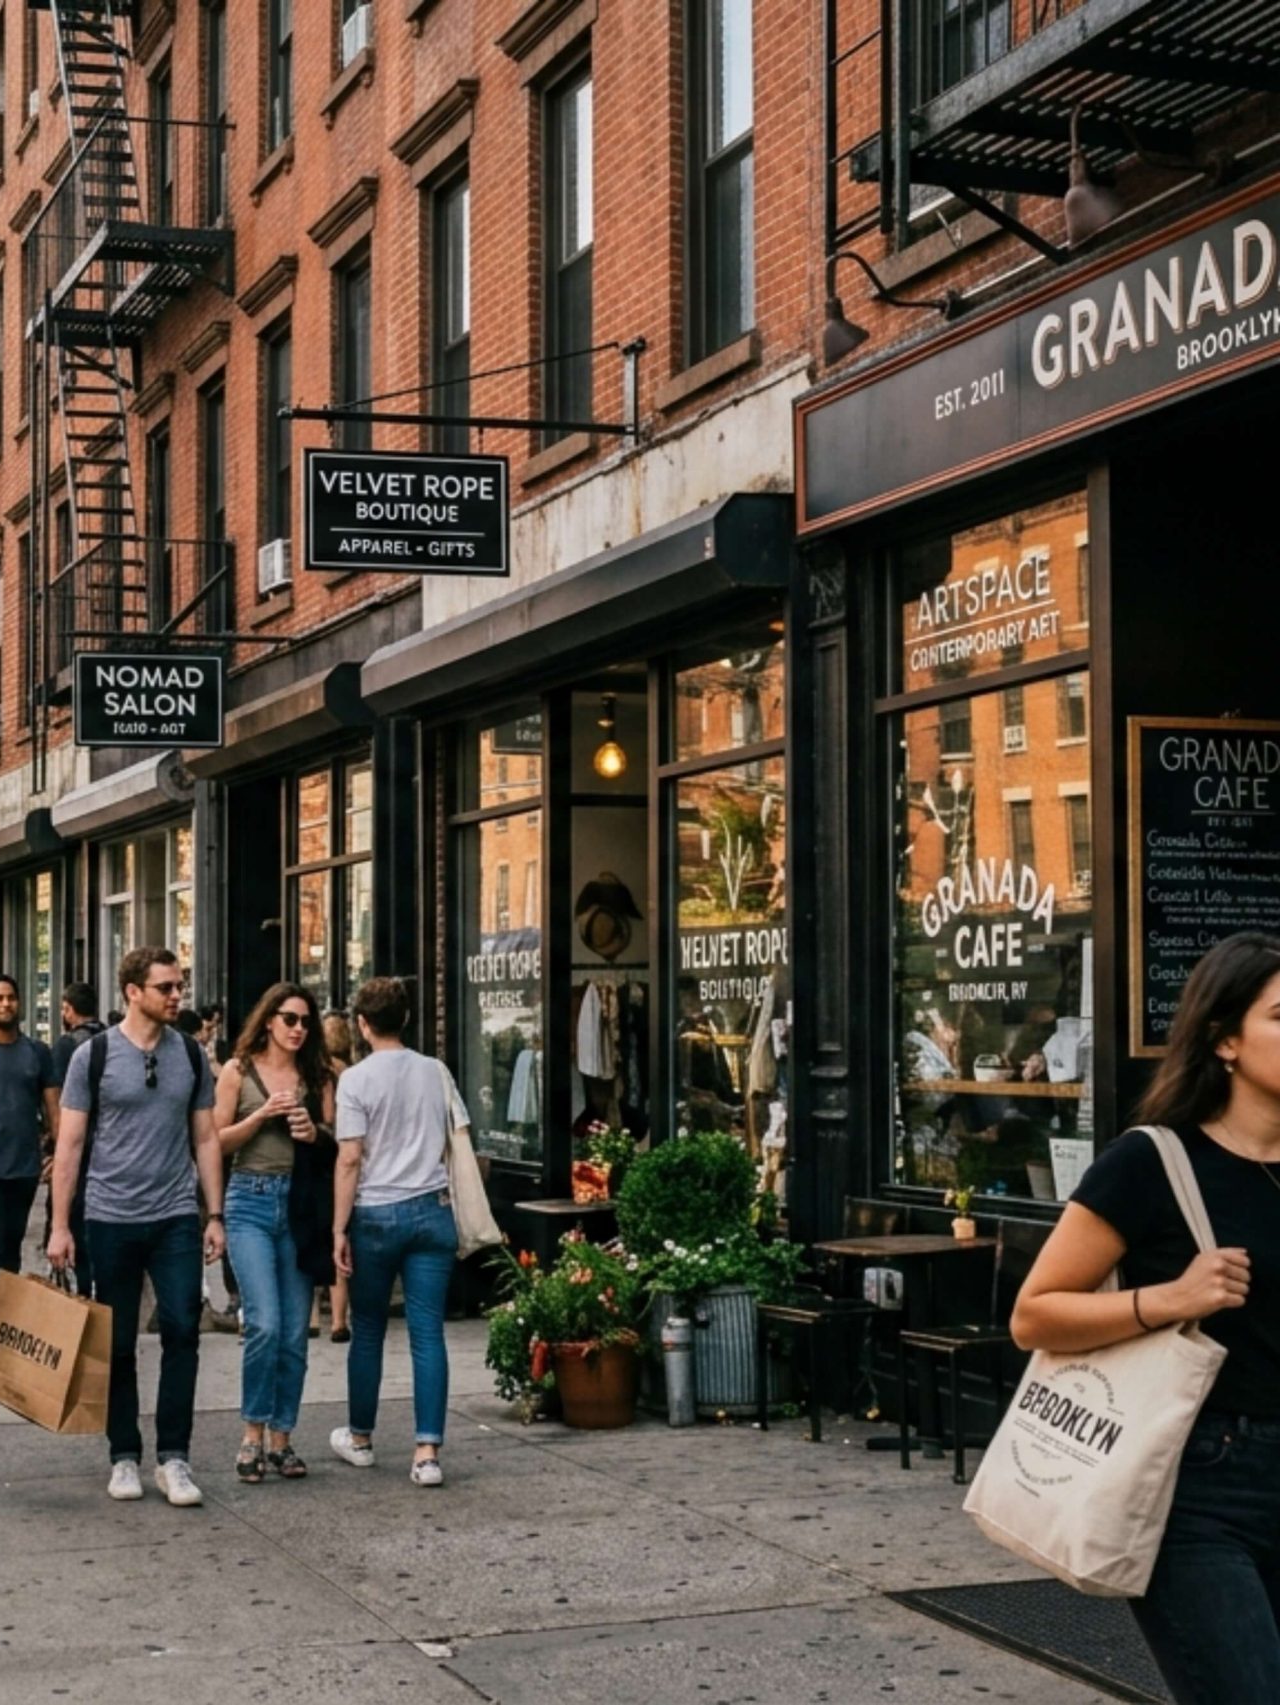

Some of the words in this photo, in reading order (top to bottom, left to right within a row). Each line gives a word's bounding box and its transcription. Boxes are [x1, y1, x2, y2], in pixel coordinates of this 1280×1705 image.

[1032, 219, 1280, 390] GRANAD
[934, 386, 966, 421] EST.
[970, 368, 1005, 405] 2011
[319, 470, 416, 496] VELVET
[424, 475, 494, 501] ROPE
[356, 501, 459, 525] BOUTIQUE
[338, 538, 413, 556] APPAREL
[916, 553, 1051, 630] ARTSPACE
[95, 665, 205, 689] NOMAD
[104, 691, 196, 716] SALON
[1193, 775, 1270, 809] CAFE
[922, 856, 1055, 938] GRANADA
[954, 922, 1023, 969] CAFE
